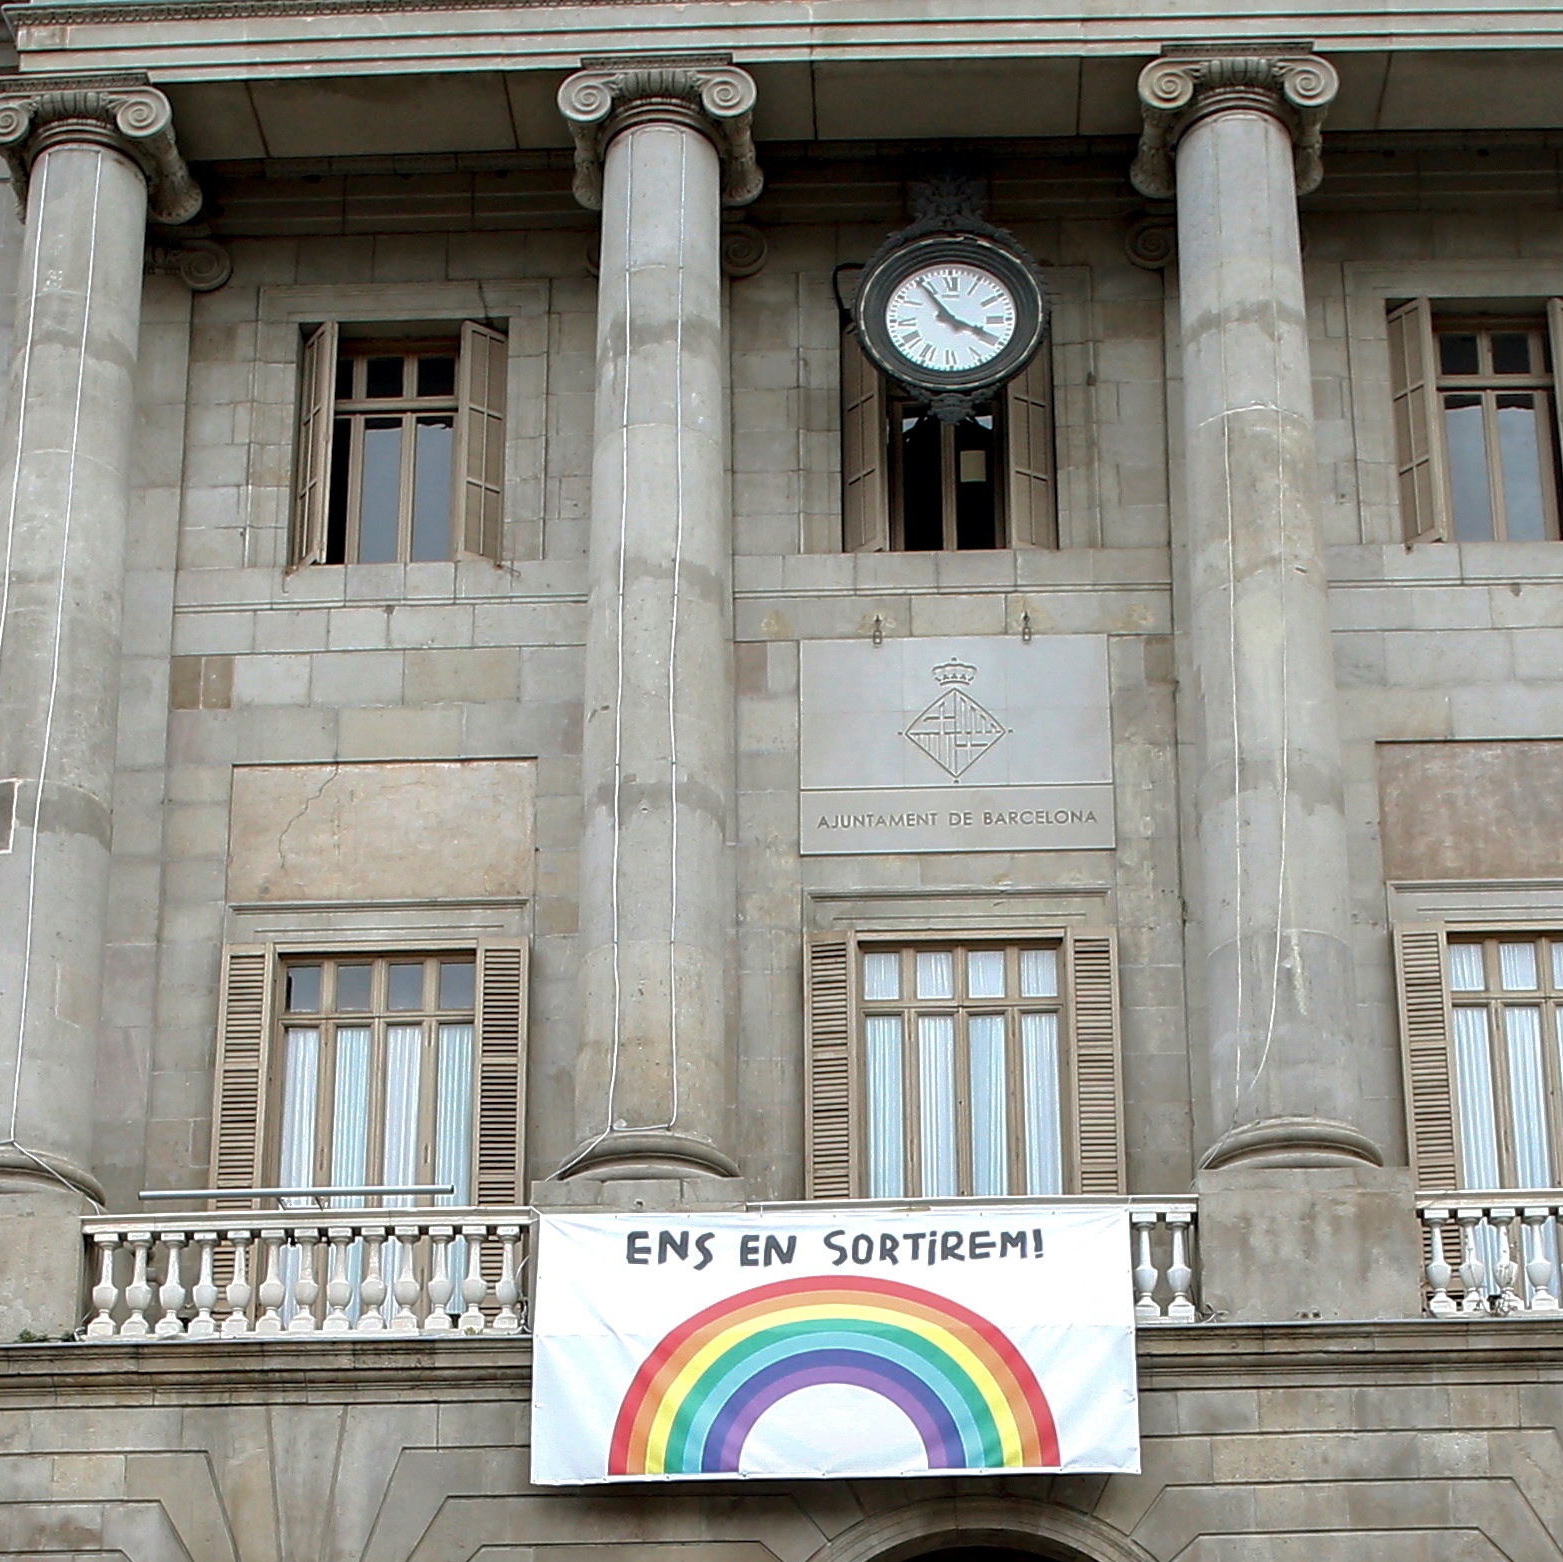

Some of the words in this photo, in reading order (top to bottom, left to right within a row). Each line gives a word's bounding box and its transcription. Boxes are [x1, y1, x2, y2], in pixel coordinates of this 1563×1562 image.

[817, 812, 939, 830] AJUNTAMENT
[948, 811, 973, 827] DE
[983, 809, 1098, 826] BARCELONA
[626, 1230, 716, 1271] ENS
[740, 1234, 797, 1267] EN
